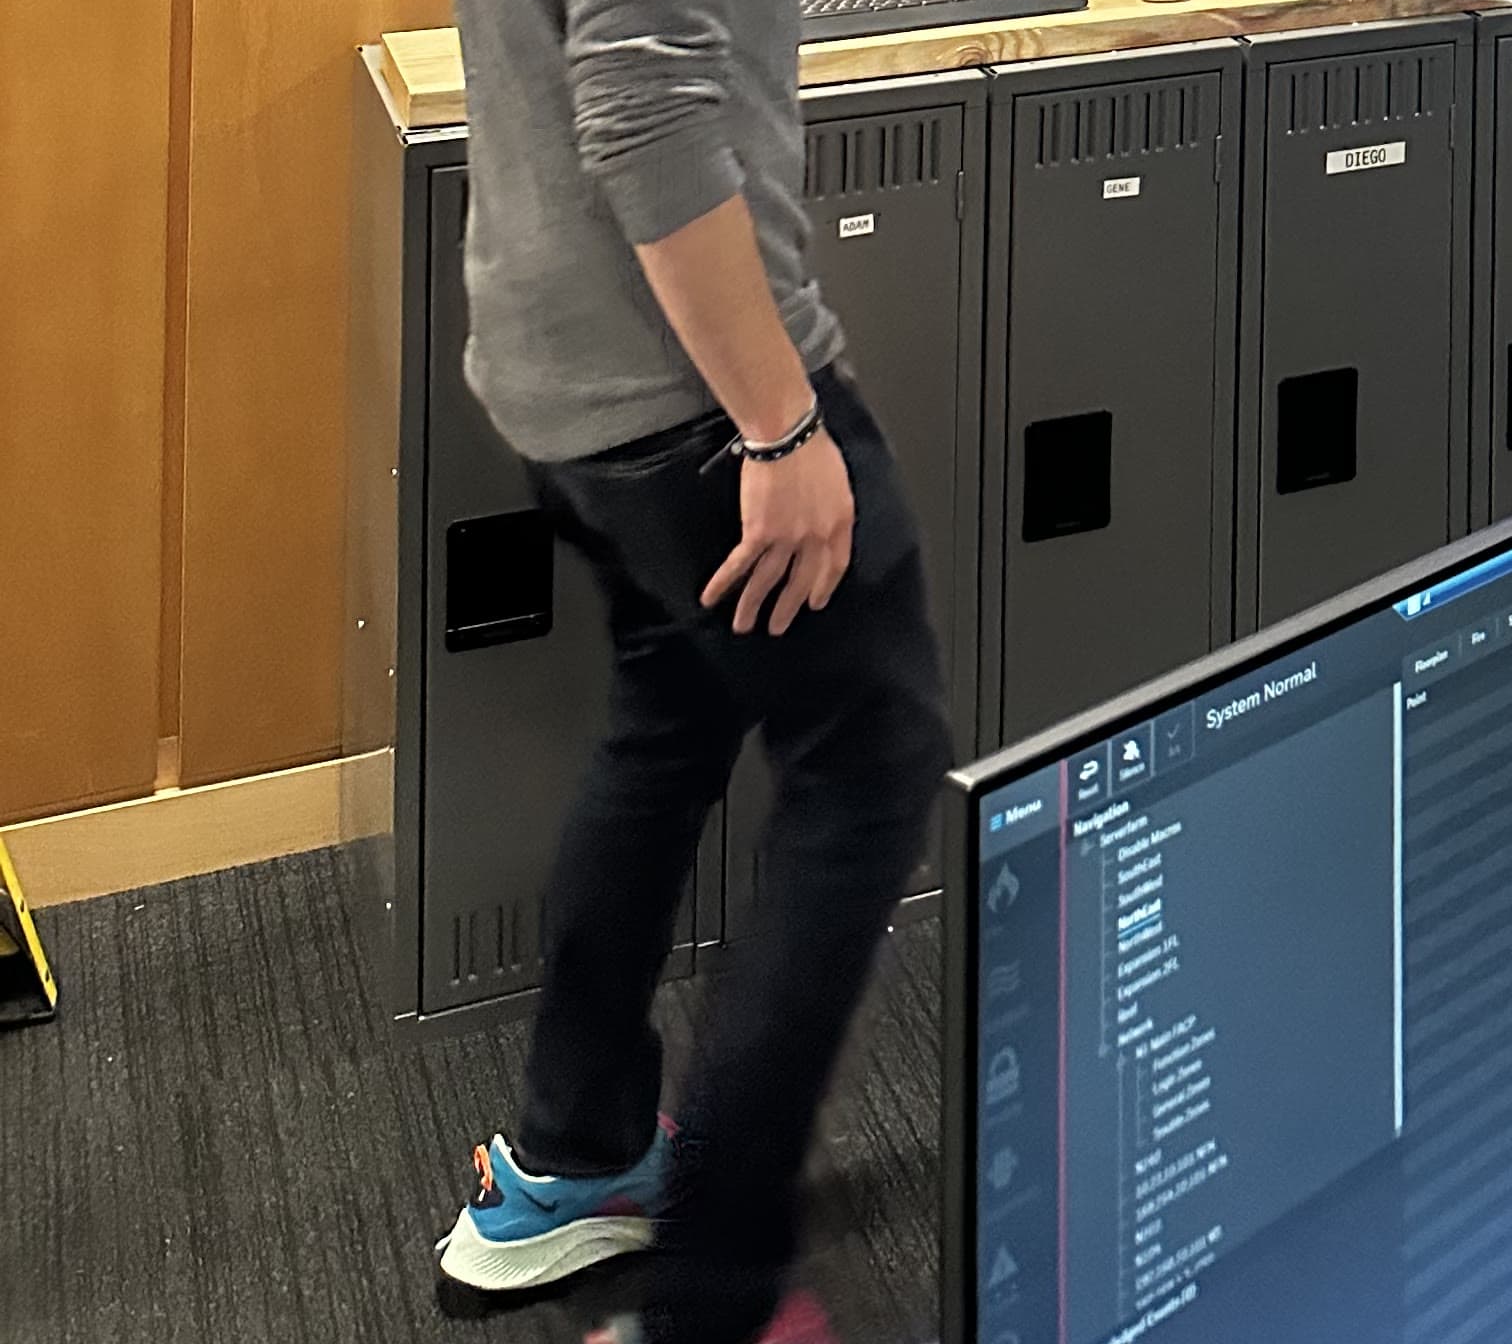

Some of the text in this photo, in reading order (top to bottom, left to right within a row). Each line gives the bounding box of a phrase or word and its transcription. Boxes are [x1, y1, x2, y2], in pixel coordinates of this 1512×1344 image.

[1344, 147, 1387, 169] DIEGO
[1105, 181, 1131, 194] GENE
[842, 219, 871, 232] ADAM
[1205, 662, 1317, 730] System Normal
[1005, 798, 1042, 825] Menu
[1073, 800, 1130, 837] Navigation
